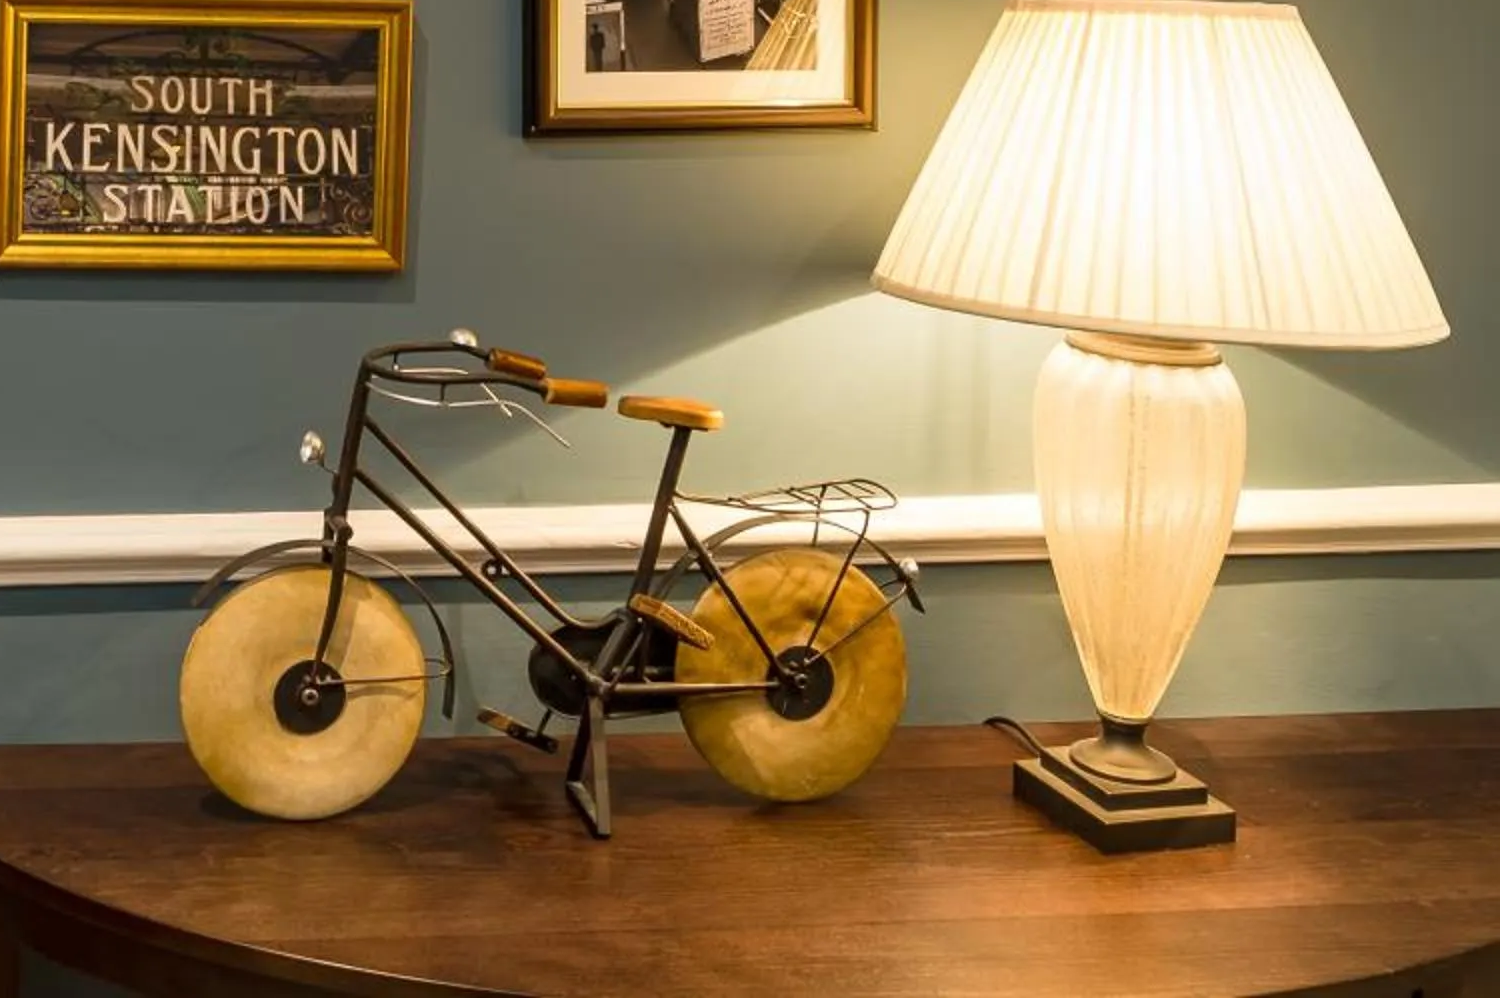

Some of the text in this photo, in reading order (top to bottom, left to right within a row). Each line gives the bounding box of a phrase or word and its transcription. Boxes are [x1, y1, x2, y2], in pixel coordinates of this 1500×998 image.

[130, 74, 273, 117] SOUTH
[44, 121, 360, 176] KENSINGTON
[103, 183, 304, 225] STATION
